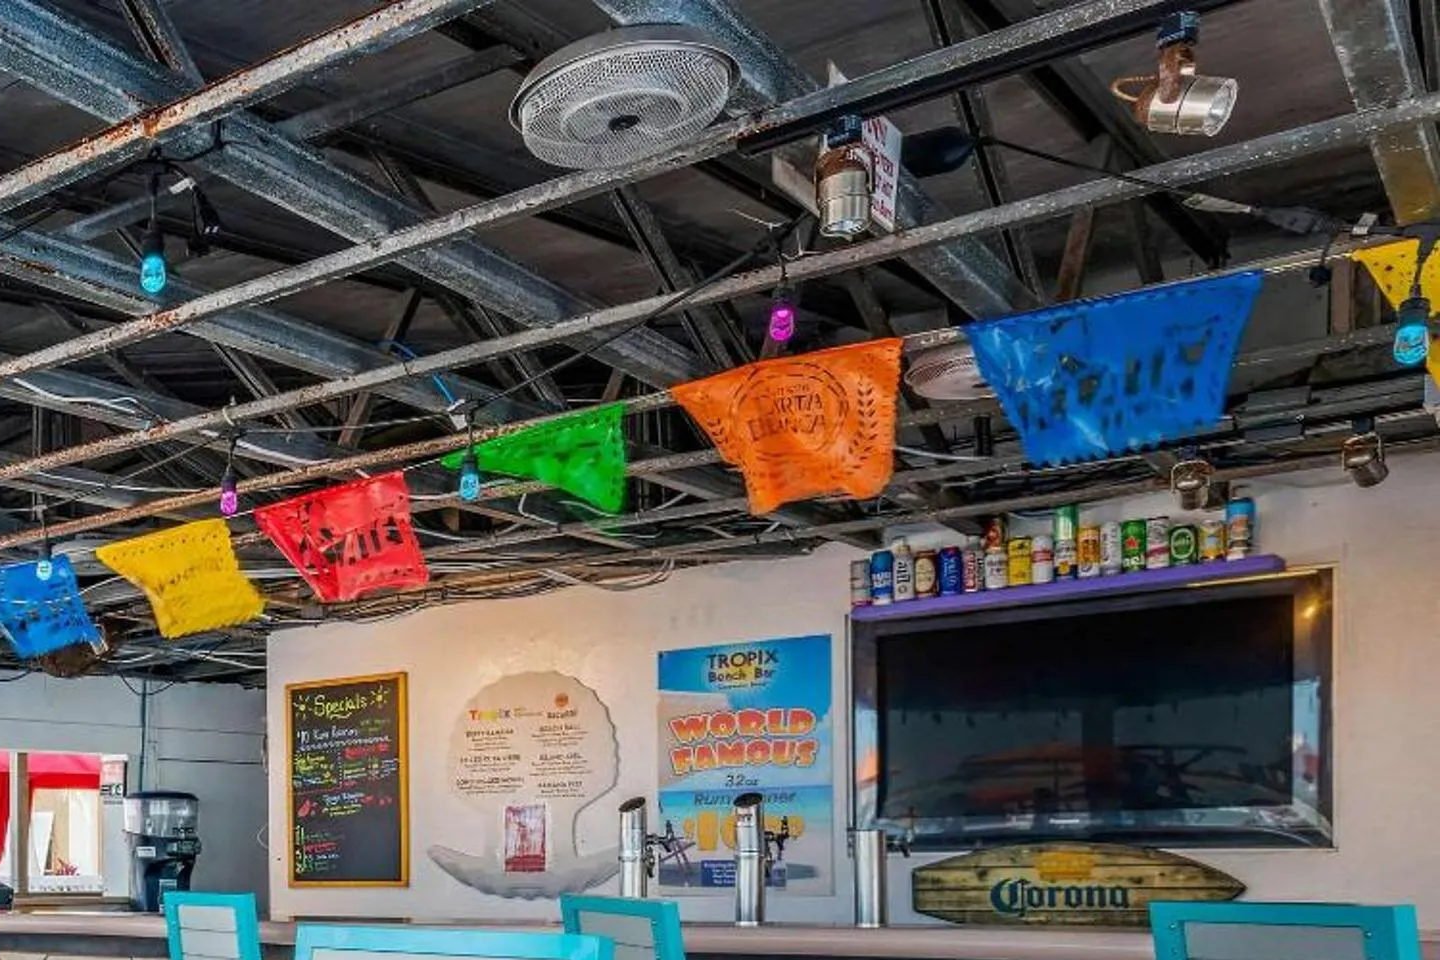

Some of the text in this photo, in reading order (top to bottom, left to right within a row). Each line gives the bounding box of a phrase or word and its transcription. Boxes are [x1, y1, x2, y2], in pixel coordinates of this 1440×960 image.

[707, 649, 779, 668] TROPIX
[708, 665, 775, 682] Beach Bar
[314, 693, 368, 718] Specials
[669, 708, 816, 743] WORLD
[670, 738, 819, 776] FAMOUS
[989, 877, 1130, 916] Corona
